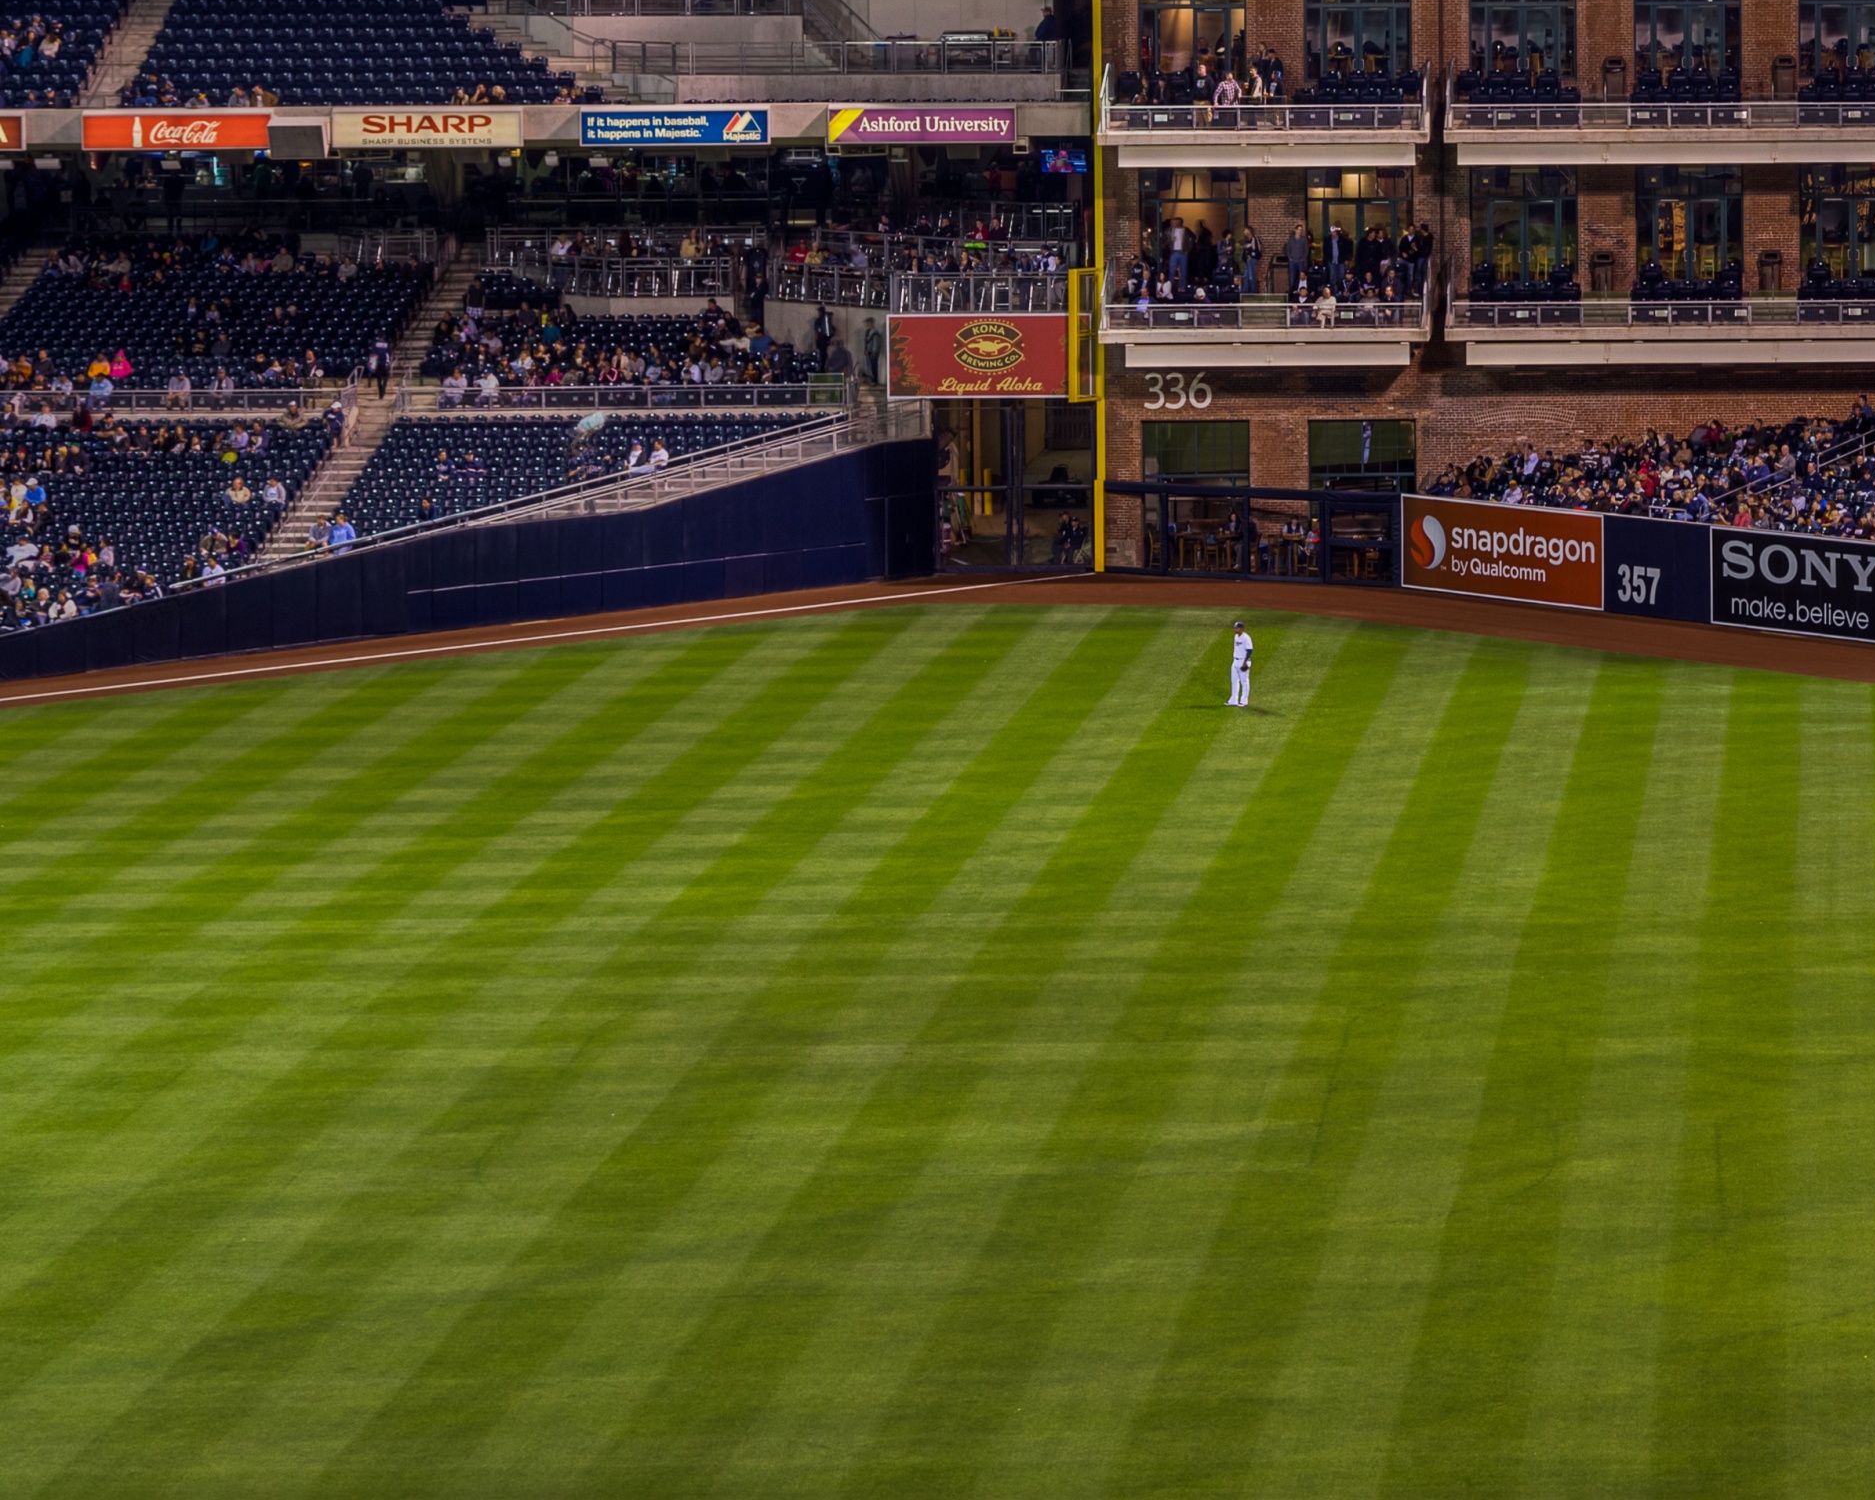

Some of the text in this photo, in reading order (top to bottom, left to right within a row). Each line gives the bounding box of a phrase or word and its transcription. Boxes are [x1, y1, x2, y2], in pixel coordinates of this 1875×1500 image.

[150, 120, 221, 144] Coca-Cola
[362, 115, 491, 133] SHARP
[587, 116, 709, 128] If it happens in baseball,
[859, 114, 1010, 136] Ashford University
[587, 128, 702, 140] it happens in Majestic.
[723, 132, 761, 142] Majestic
[972, 325, 1005, 335] KONA
[961, 353, 1003, 367] BREWING
[938, 376, 1042, 395] Liquid Aloha
[1143, 371, 1212, 409] 336
[1451, 525, 1595, 565] snapdragon
[1451, 556, 1546, 583] by Qualcomm
[1617, 563, 1661, 604] 357
[1731, 596, 1869, 629] make.believe
